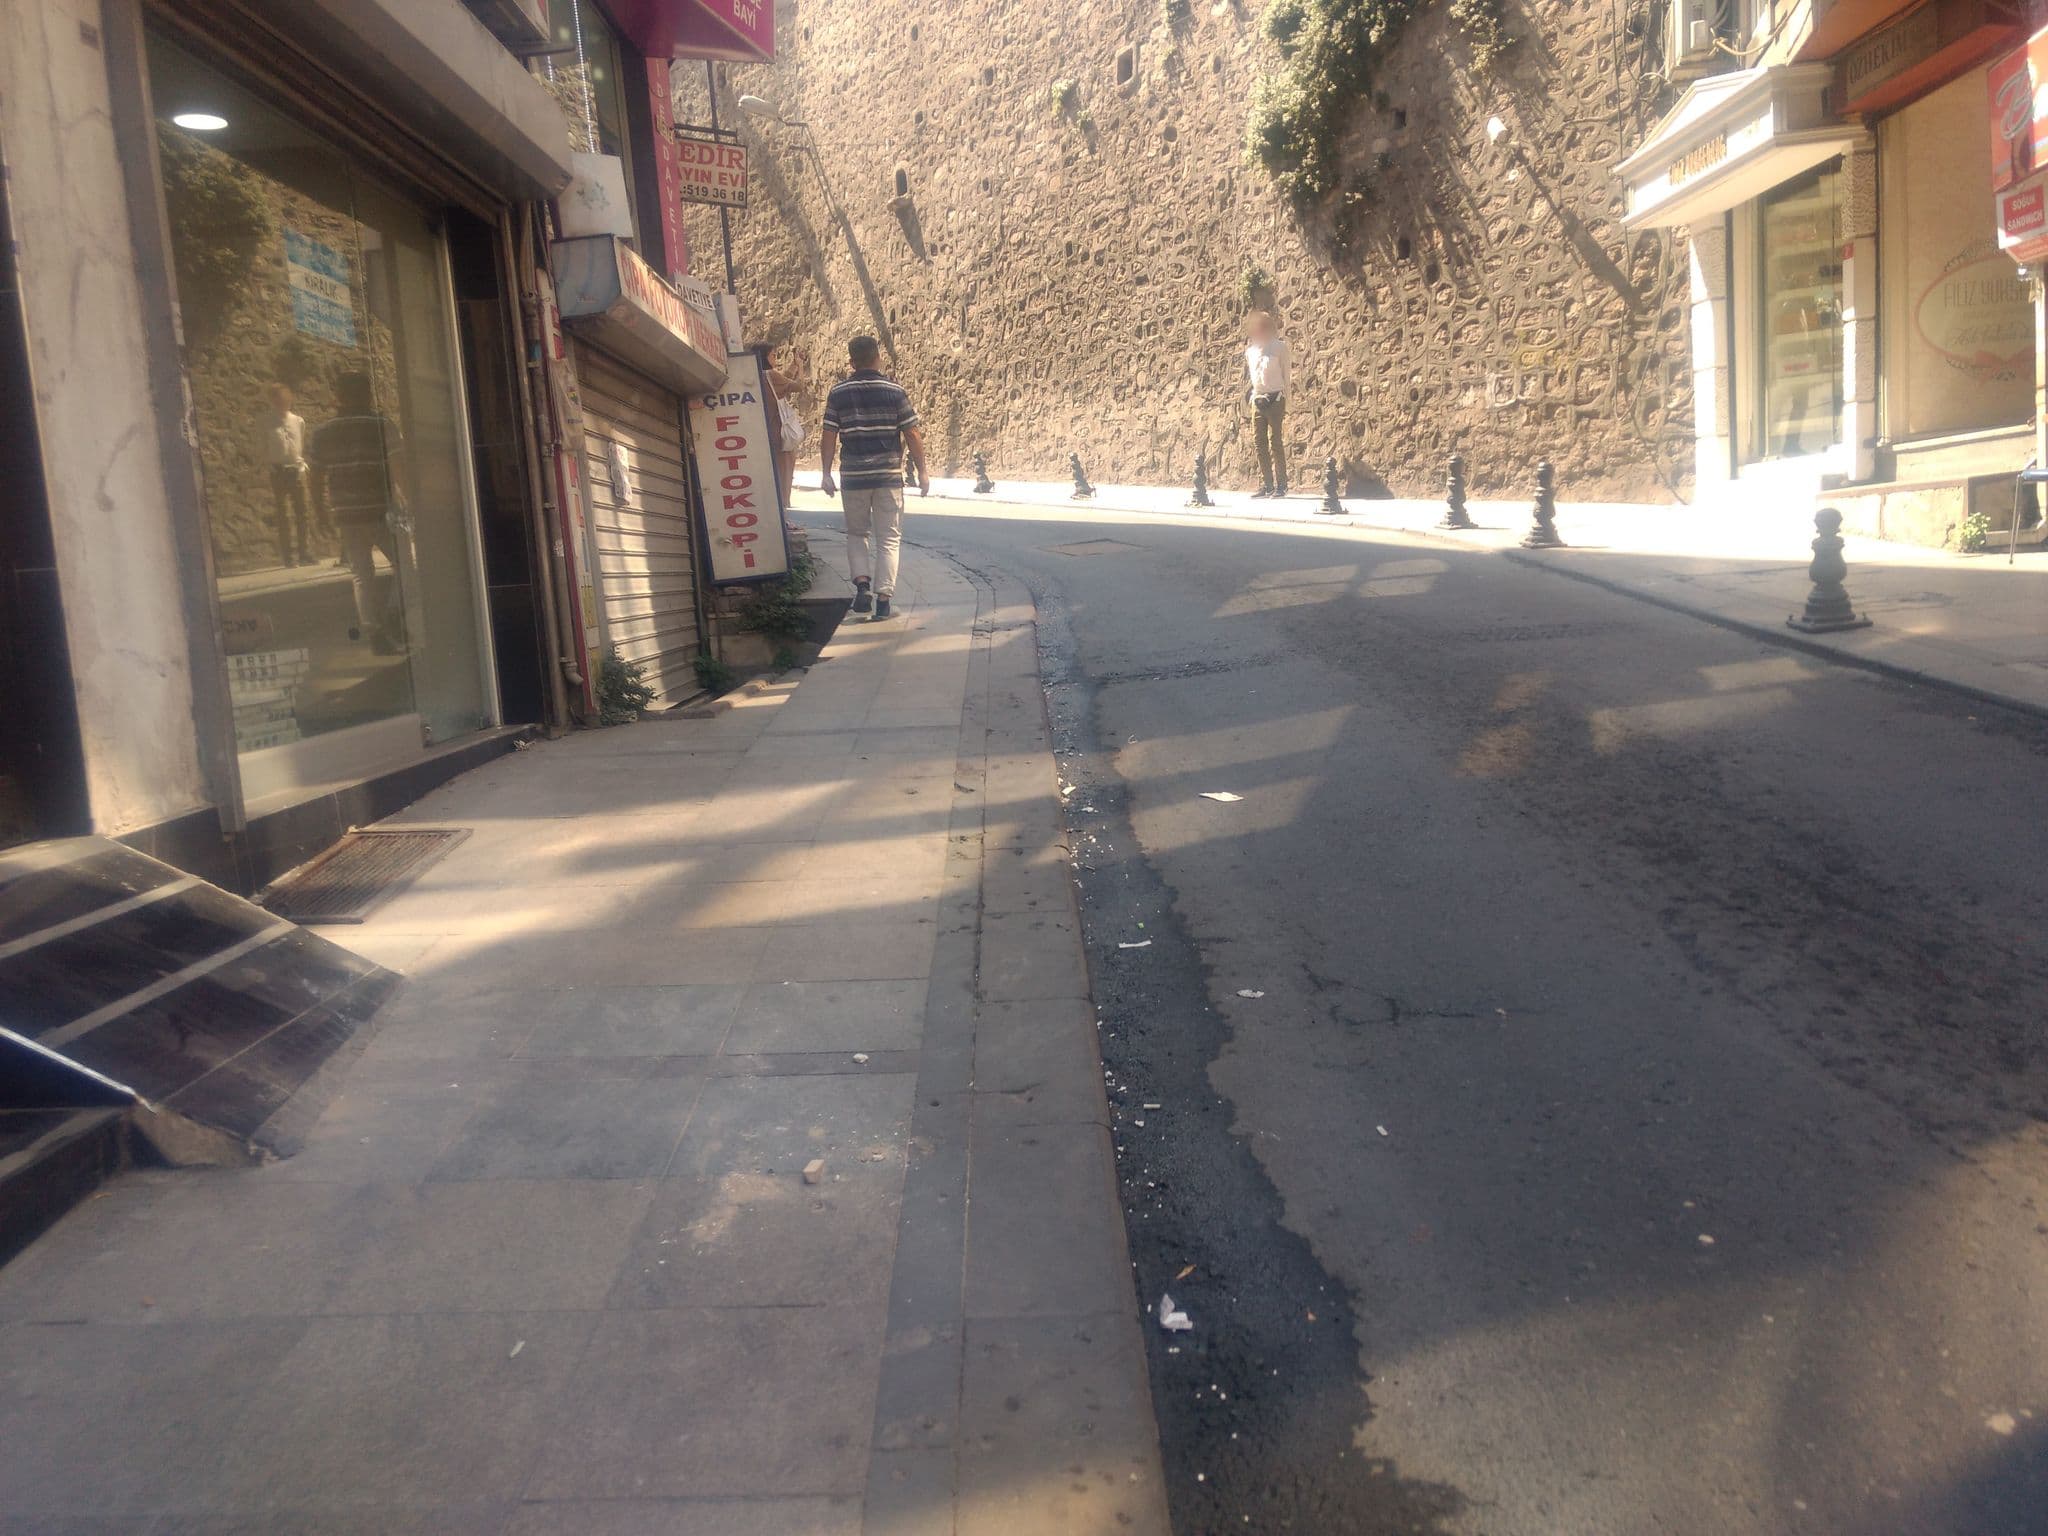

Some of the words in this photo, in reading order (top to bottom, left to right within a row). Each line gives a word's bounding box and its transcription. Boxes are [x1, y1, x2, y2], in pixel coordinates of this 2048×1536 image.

[678, 141, 745, 170] EDİR
[712, 187, 727, 200] 36
[732, 190, 745, 202] 18
[663, 145, 680, 274] DAVETİ
[703, 391, 757, 410] ÇIPA
[714, 415, 758, 569] FOTOKOPİ
